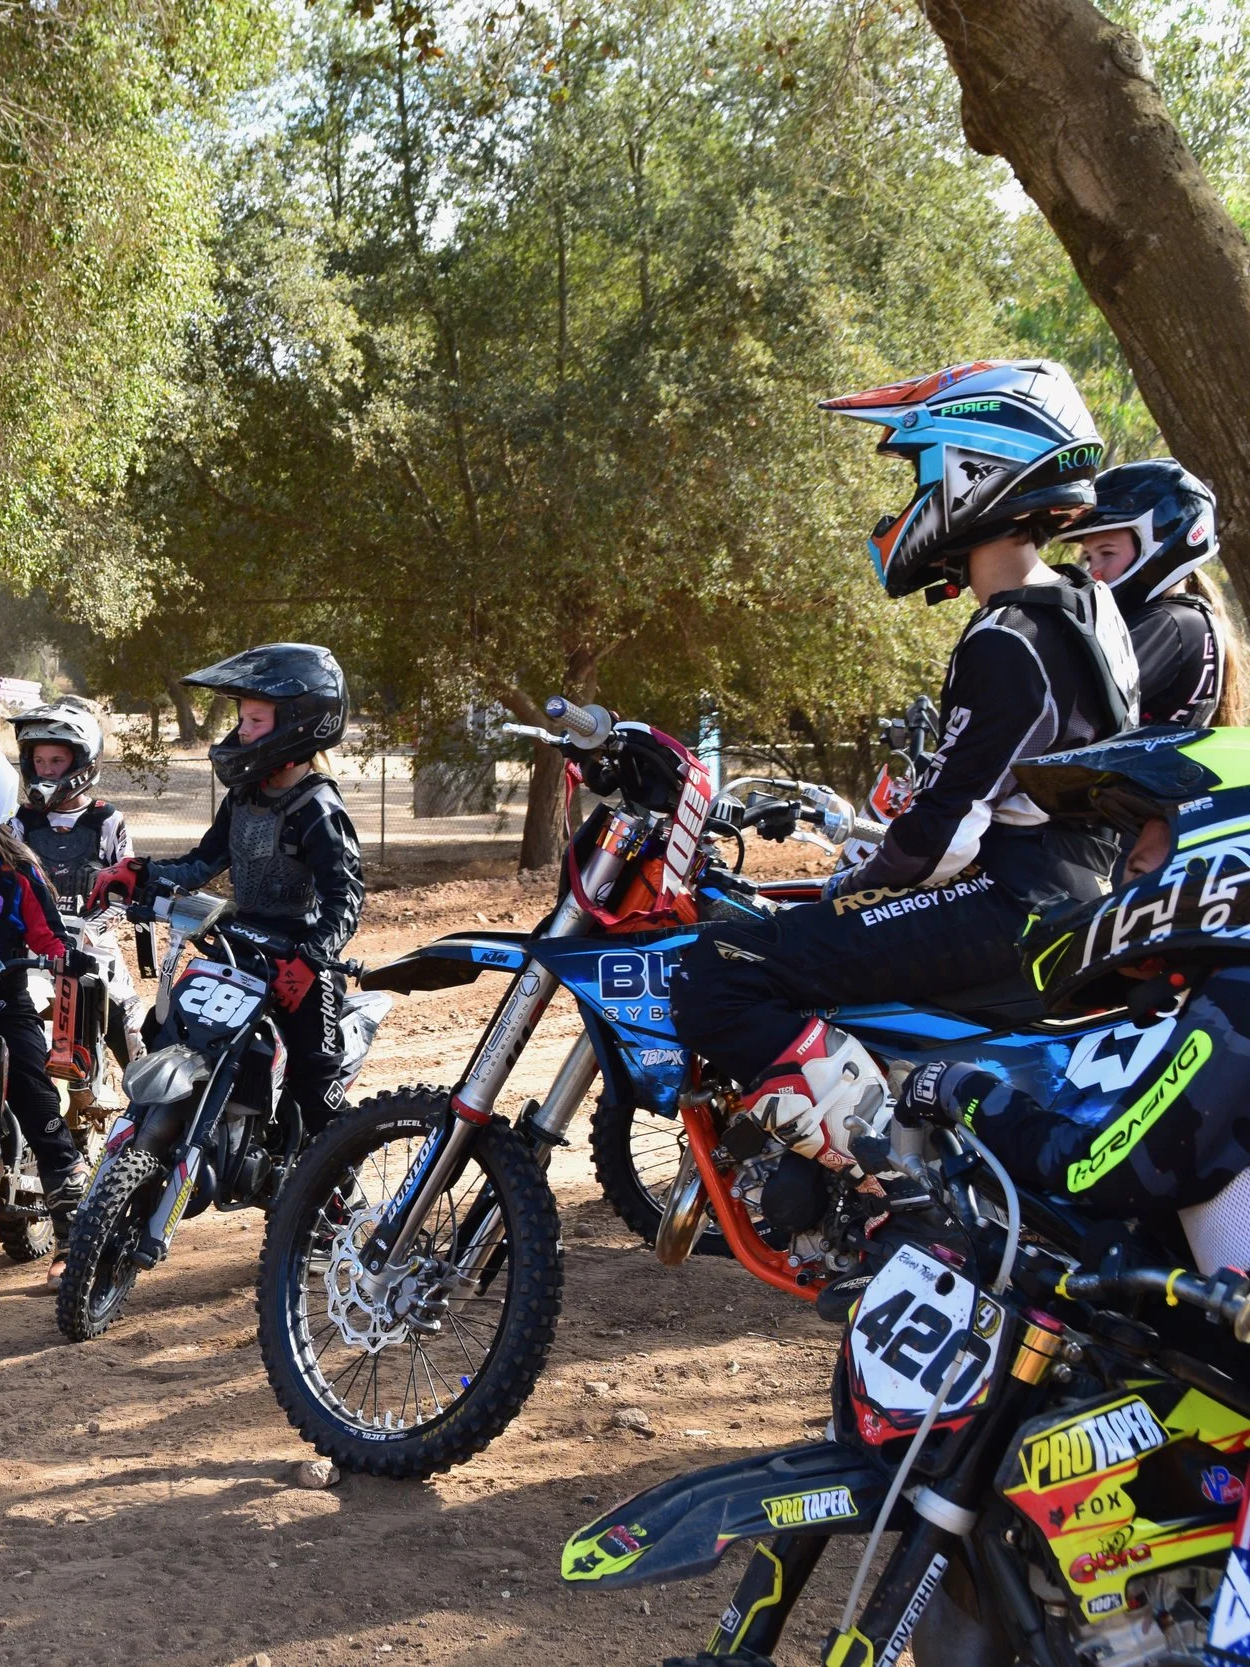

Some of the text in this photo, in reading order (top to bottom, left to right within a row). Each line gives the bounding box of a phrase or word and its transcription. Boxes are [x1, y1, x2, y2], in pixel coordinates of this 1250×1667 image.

[70, 771, 90, 789] FLY
[860, 890, 940, 927] ENERGY
[479, 950, 511, 965] KTM
[58, 978, 73, 1035] SCO
[178, 976, 262, 1028] 281
[319, 969, 333, 1055] FASTHOUS
[602, 1005, 666, 1022] CYB
[480, 1003, 529, 1083] SUSPENSION
[397, 1119, 423, 1128] EXCEL
[387, 1126, 438, 1224] DUNLOP
[855, 1288, 991, 1405] 420
[361, 1431, 386, 1441] EXCEL
[1031, 1401, 1164, 1489] PROTAPER
[770, 1488, 852, 1526] PROTAPER
[1074, 1491, 1122, 1520] FOX
